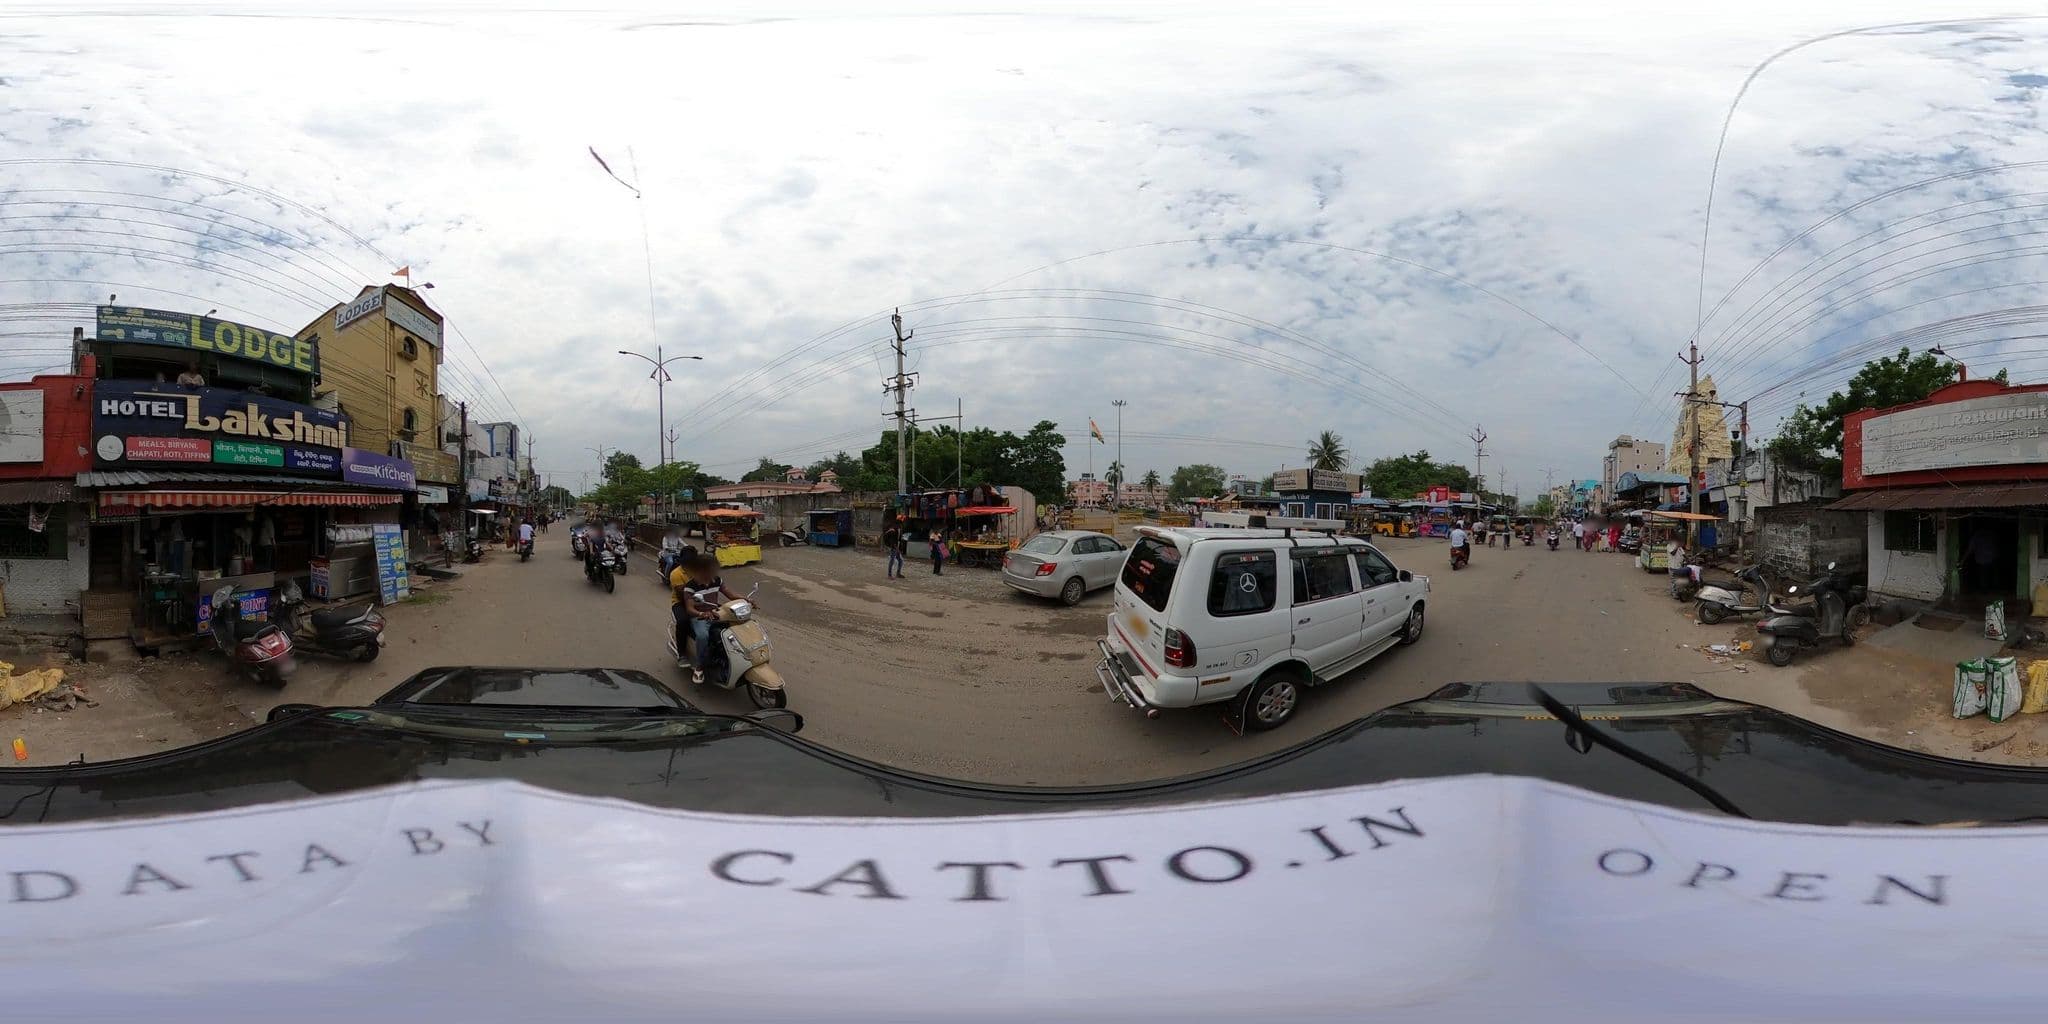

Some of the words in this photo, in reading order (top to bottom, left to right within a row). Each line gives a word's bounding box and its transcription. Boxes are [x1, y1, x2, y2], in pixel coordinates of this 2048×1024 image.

[336, 294, 380, 327] LODGE
[190, 315, 313, 372] LODGE
[101, 399, 184, 419] HOTEL
[184, 394, 347, 449] Lakshmi
[127, 450, 162, 458] CHAPATI,
[138, 440, 166, 448] MEALS,
[167, 441, 199, 450] BIRYANI,
[375, 464, 413, 483] Kitchen
[8, 842, 349, 902] DATA
[401, 819, 497, 855] BY
[708, 806, 1426, 901] CATTO.IN
[1597, 847, 1951, 906] OPEN
